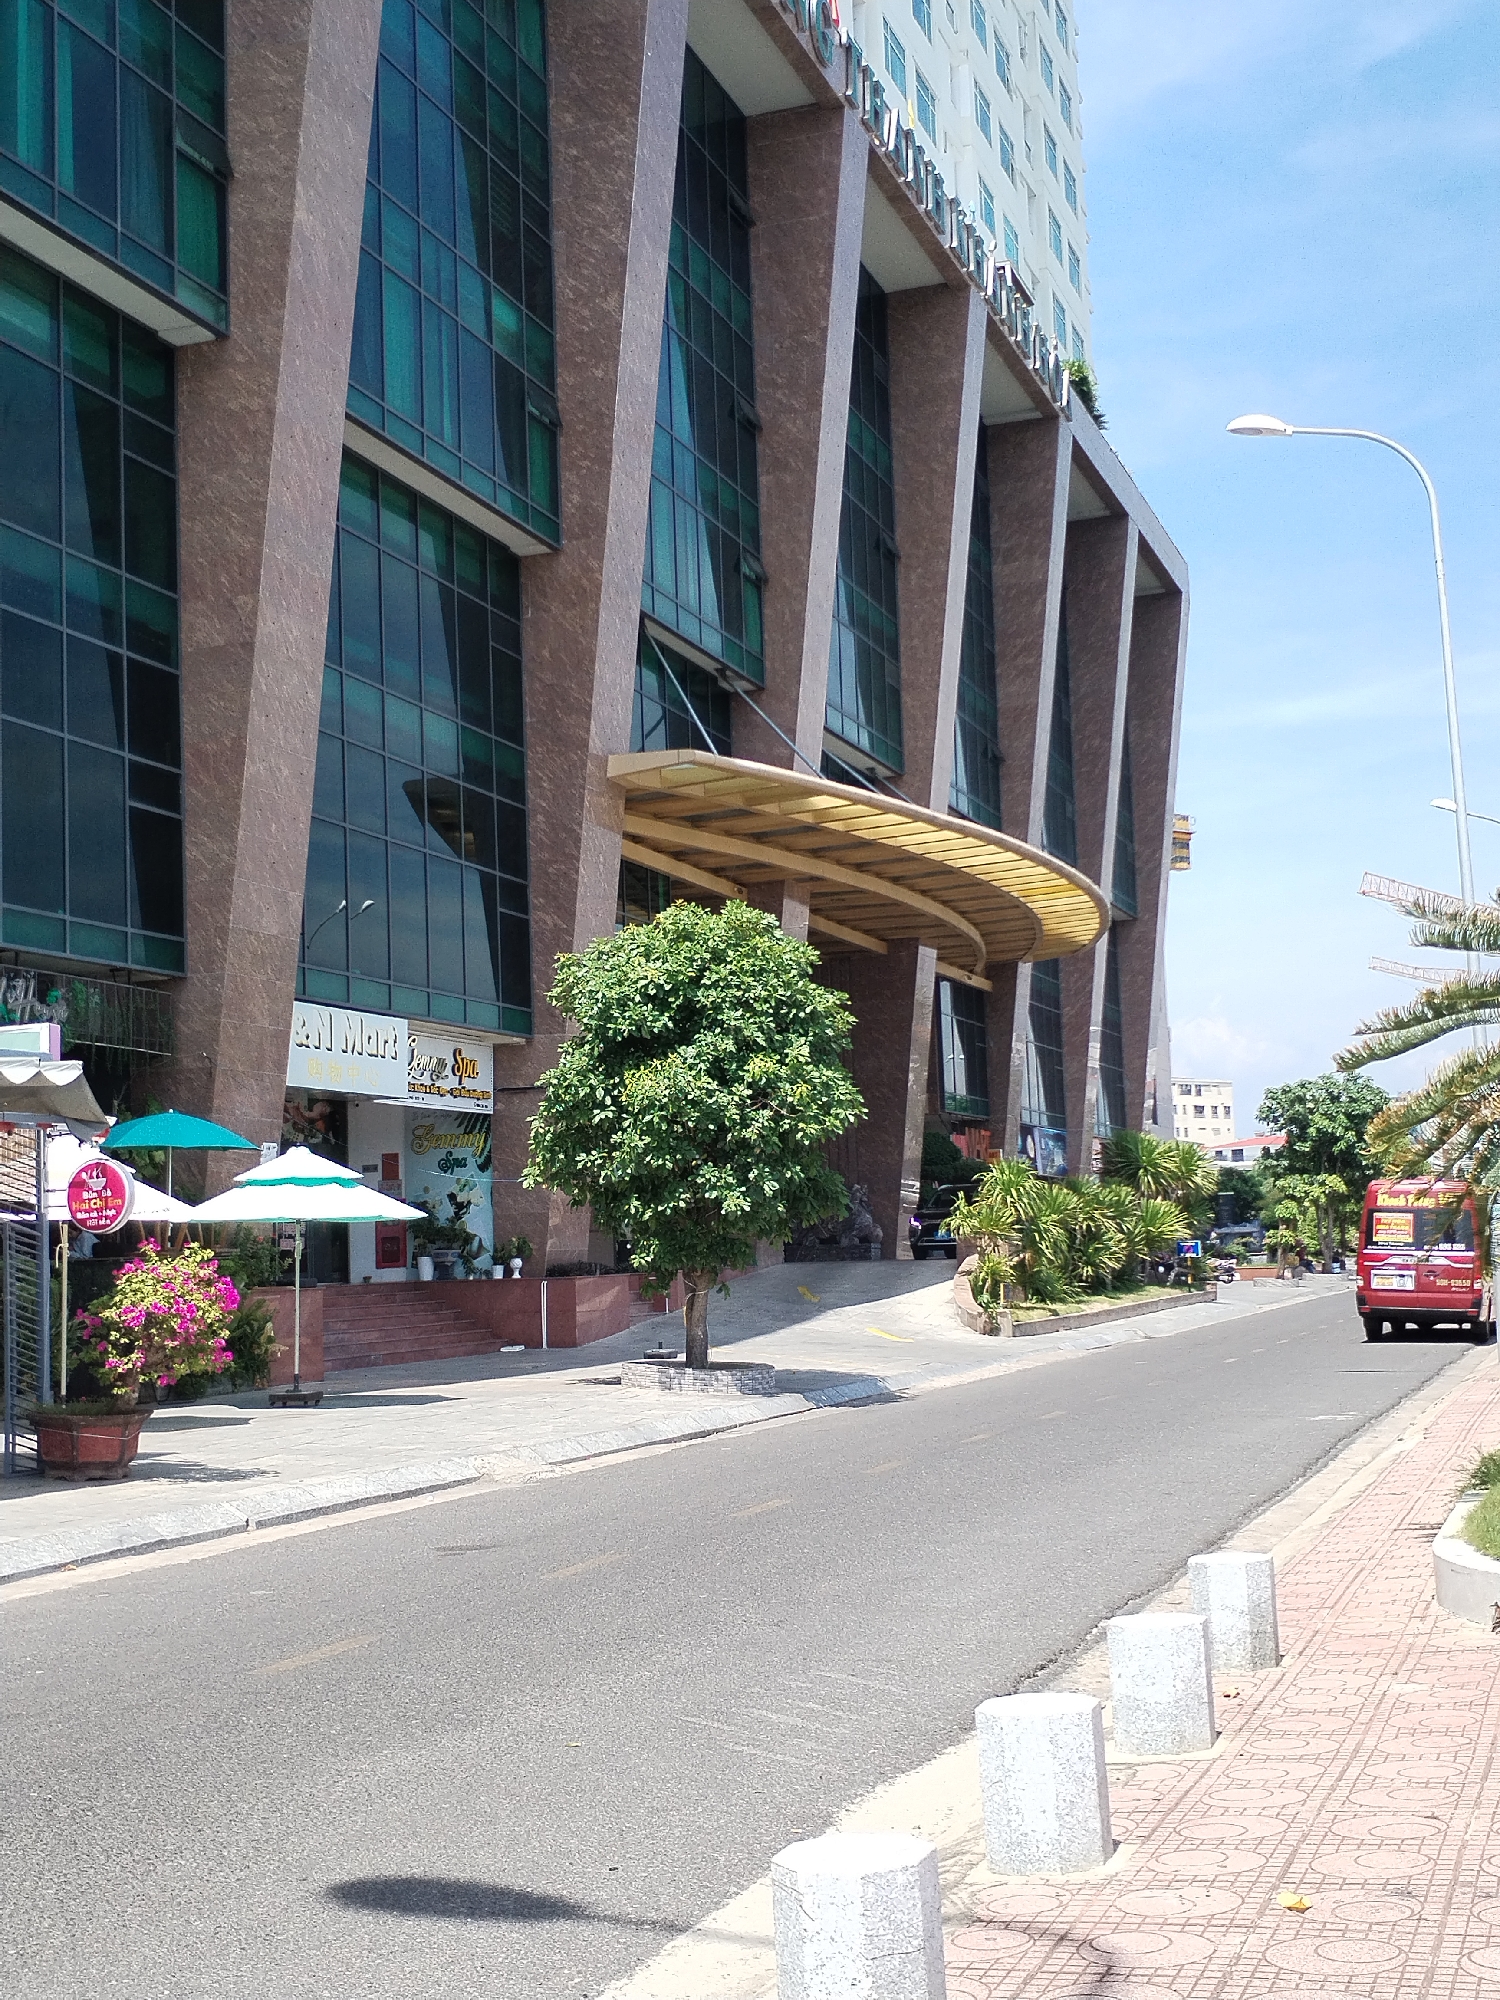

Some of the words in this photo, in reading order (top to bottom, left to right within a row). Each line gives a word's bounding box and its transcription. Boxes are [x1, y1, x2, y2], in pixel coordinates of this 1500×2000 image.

[341, 1012, 398, 1061] Mart
[307, 1057, 379, 1087] 购物中心
[452, 1047, 480, 1085] Spa
[411, 1124, 487, 1158] Gemmy
[438, 1151, 468, 1174] Spa
[108, 1197, 122, 1206] Em
